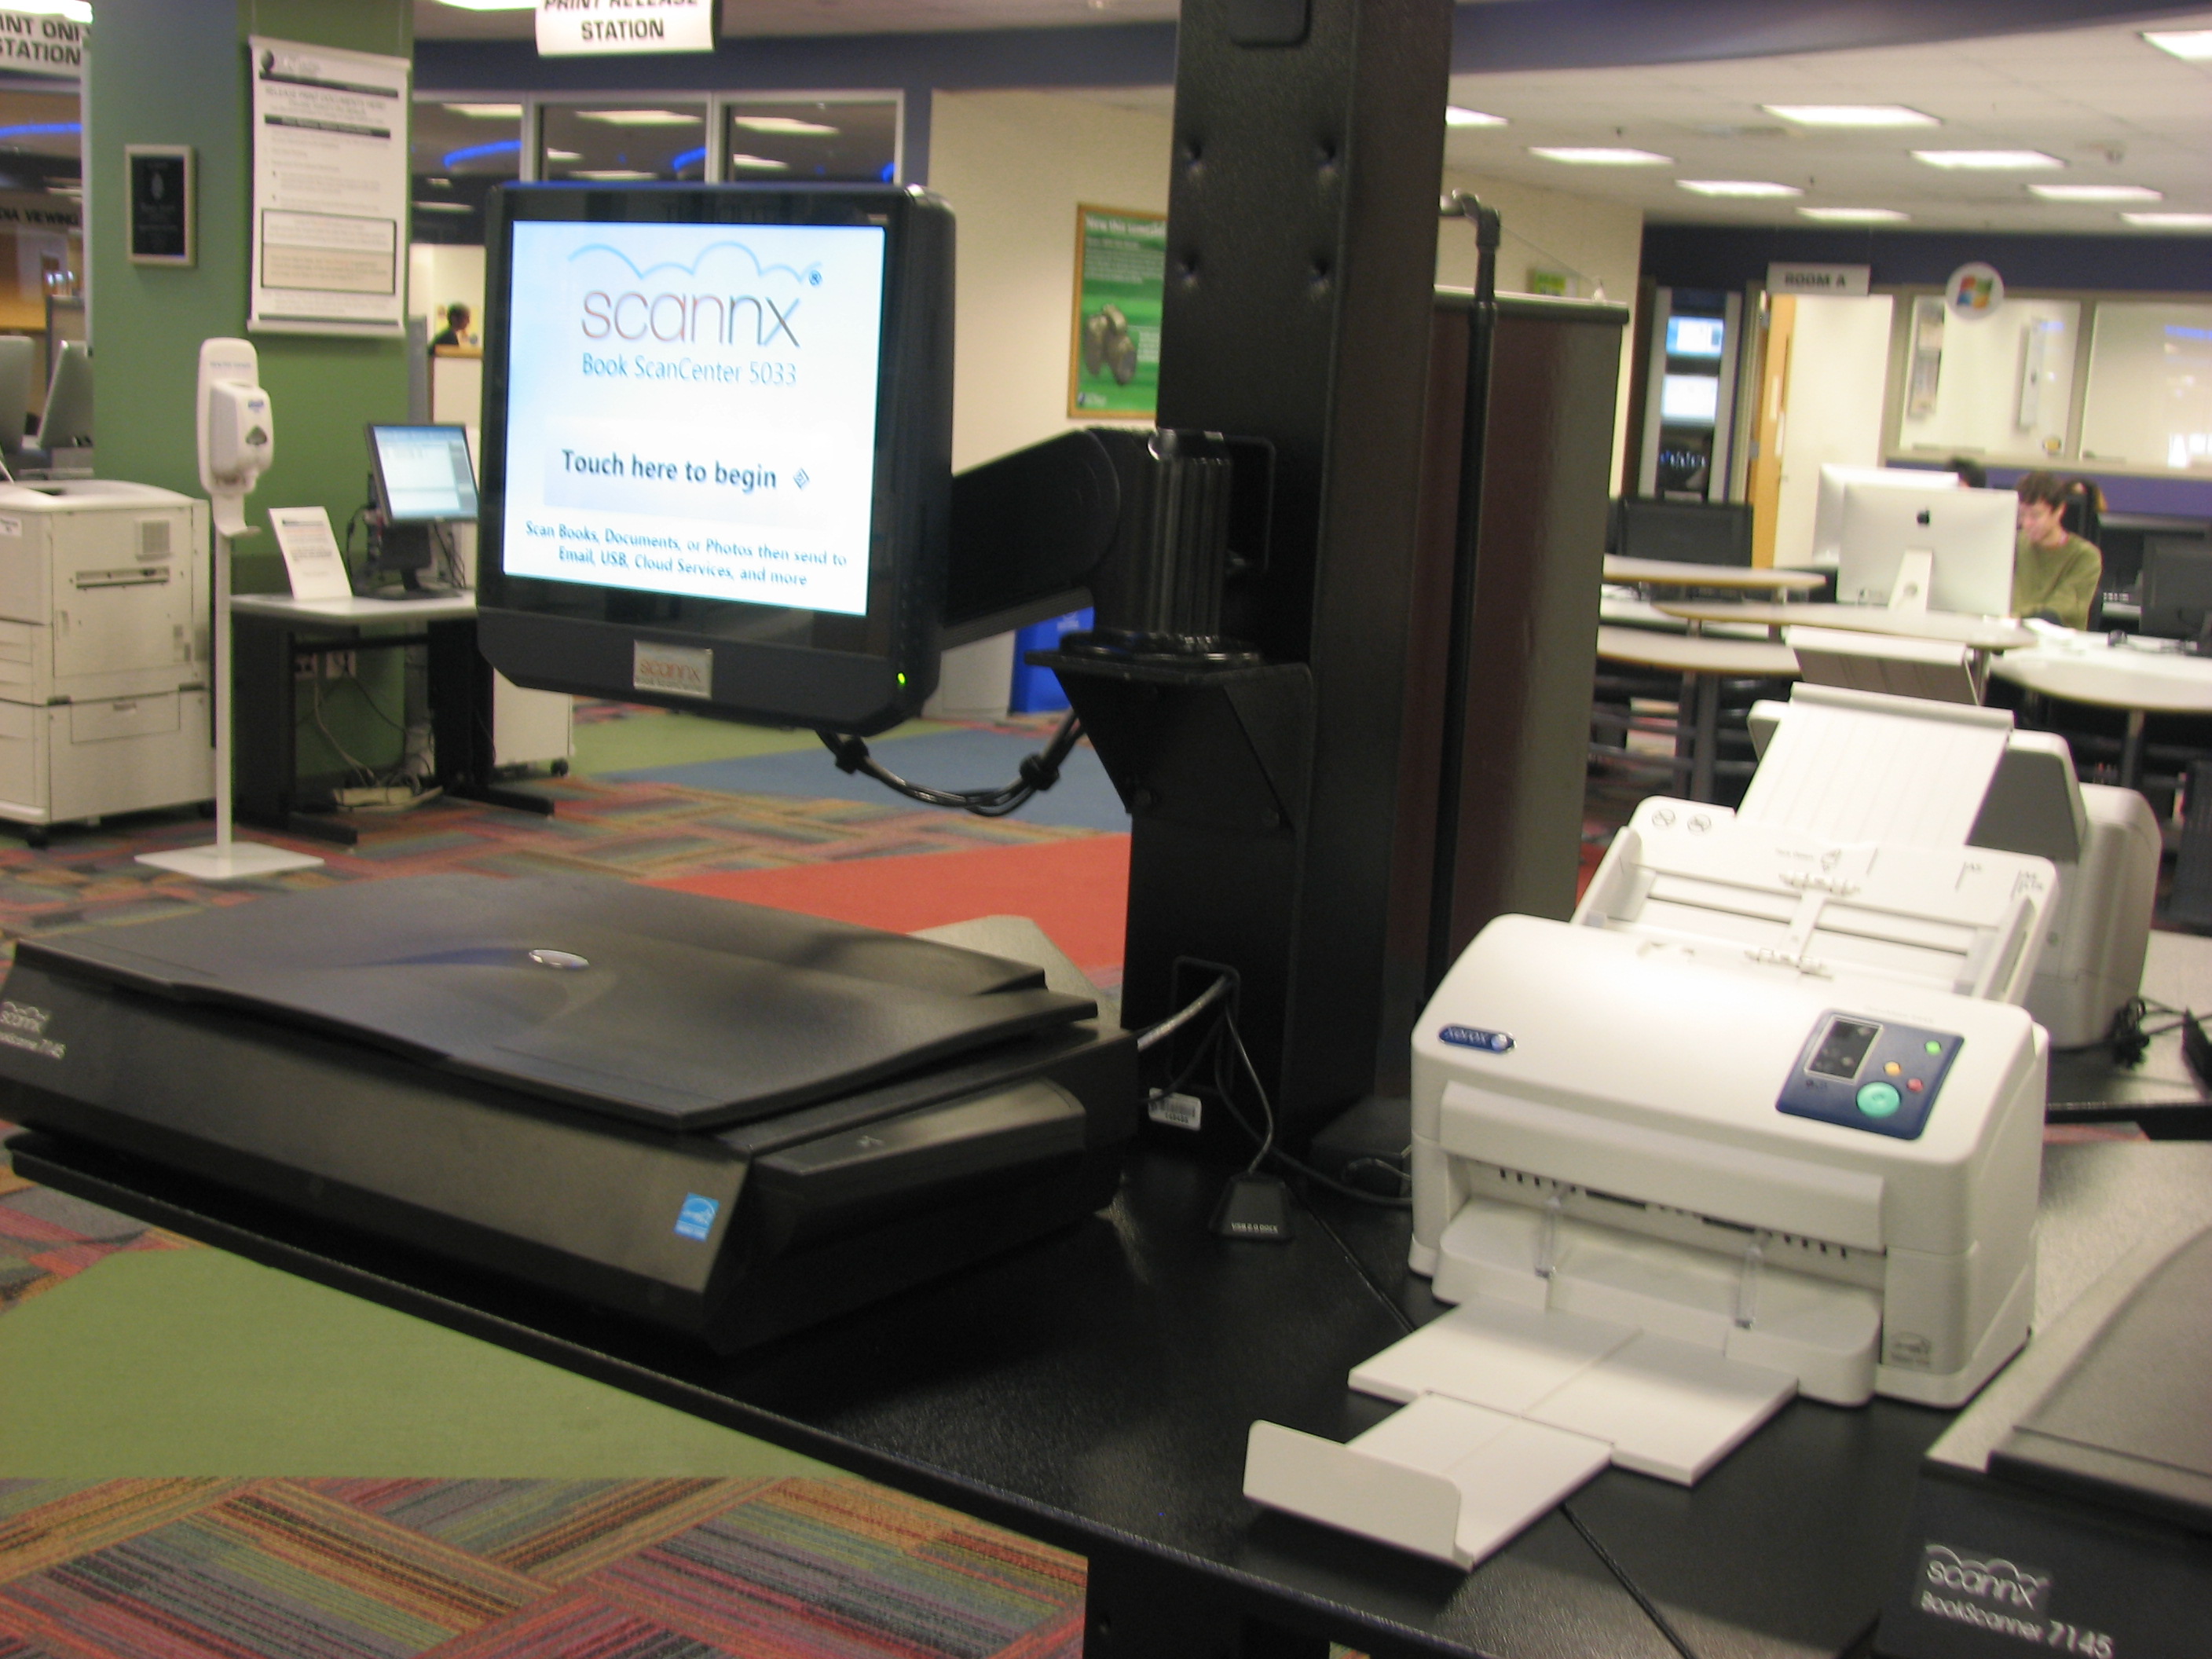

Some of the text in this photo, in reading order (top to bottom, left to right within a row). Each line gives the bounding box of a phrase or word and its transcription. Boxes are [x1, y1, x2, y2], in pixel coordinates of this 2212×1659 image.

[580, 18, 665, 40] STATION
[1784, 272, 1846, 287] ROOM A
[582, 290, 800, 348] scannx
[582, 352, 797, 386] Book ScanCenter 5033
[561, 448, 777, 494] Touch here to begin
[526, 520, 848, 566] Scan Books, Documents, or Photos then send to
[601, 549, 630, 569] USB,
[634, 553, 673, 572] Cloud
[677, 558, 734, 580] Services,
[740, 567, 766, 582] and
[771, 571, 808, 586] more
